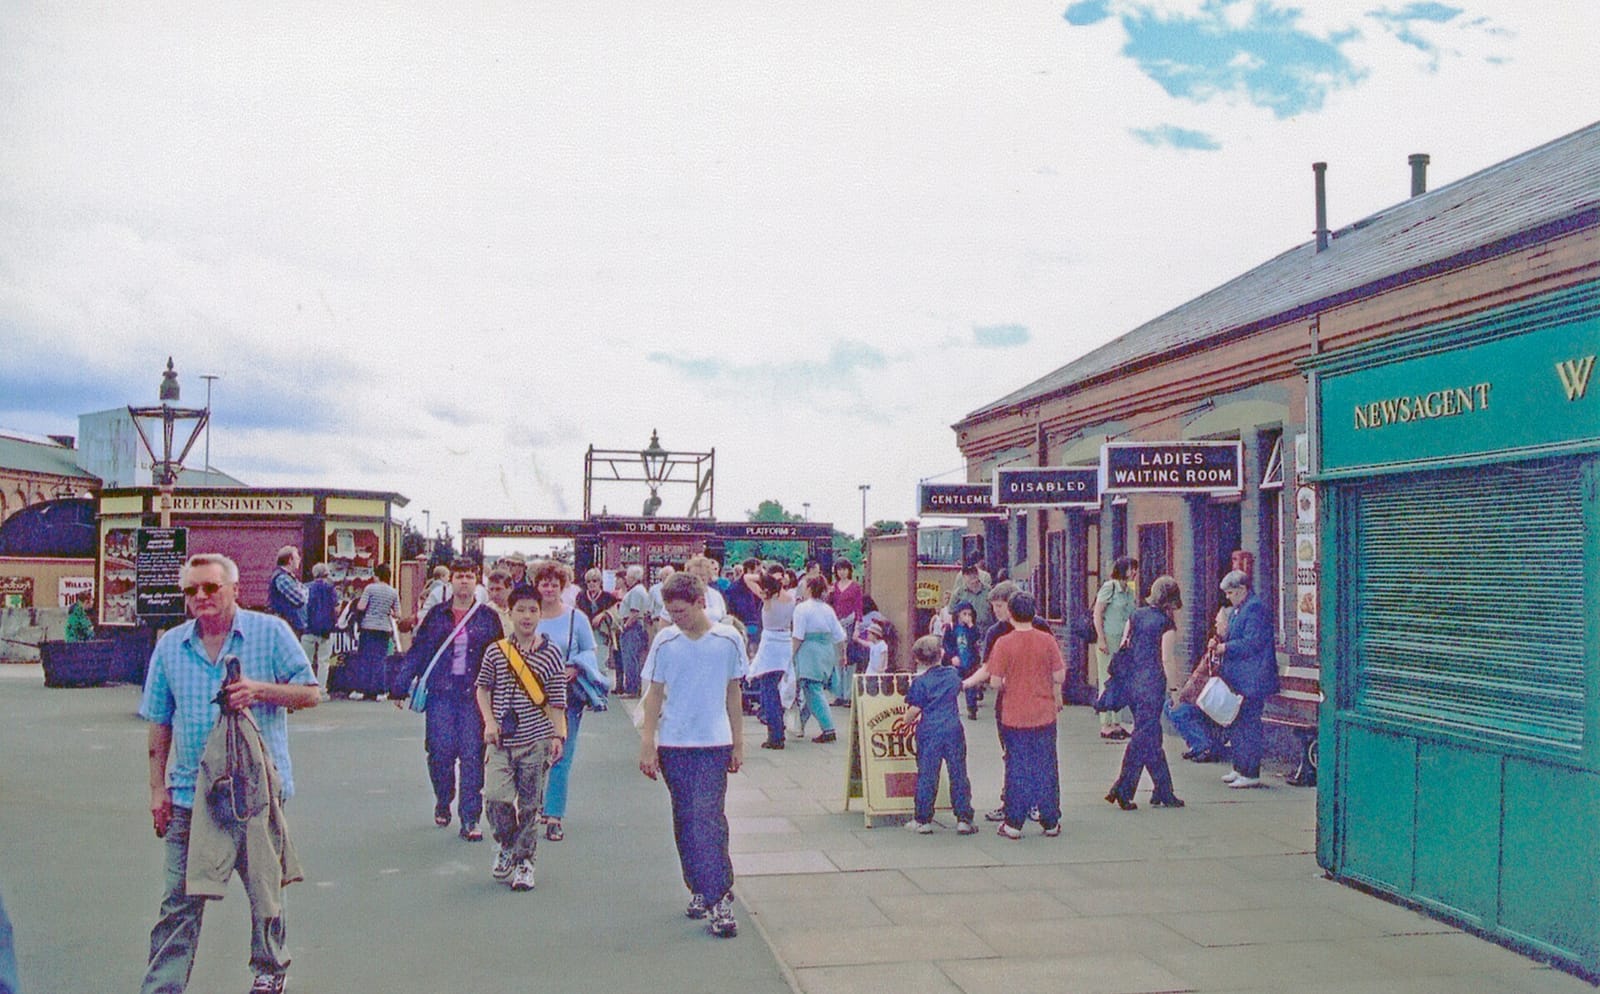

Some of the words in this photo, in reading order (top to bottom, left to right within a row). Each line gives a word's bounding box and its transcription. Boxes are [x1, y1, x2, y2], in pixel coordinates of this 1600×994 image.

[1354, 382, 1492, 430] NEWSAGENT
[1555, 355, 1597, 401] W
[1140, 453, 1204, 465] LADIES
[1114, 469, 1180, 483] WAITING
[1185, 469, 1232, 481] ROOM
[1011, 481, 1086, 492] DISABLED
[173, 498, 294, 510] REFRESHMENTS
[931, 495, 993, 504] GENTLEME
[503, 525, 547, 533] PLATFORM
[625, 523, 636, 532] TO
[640, 523, 656, 532] THE
[659, 523, 691, 532] TRAINS
[746, 527, 789, 535] PLATFORM
[791, 527, 797, 536] 2
[871, 732, 918, 758] SHO
